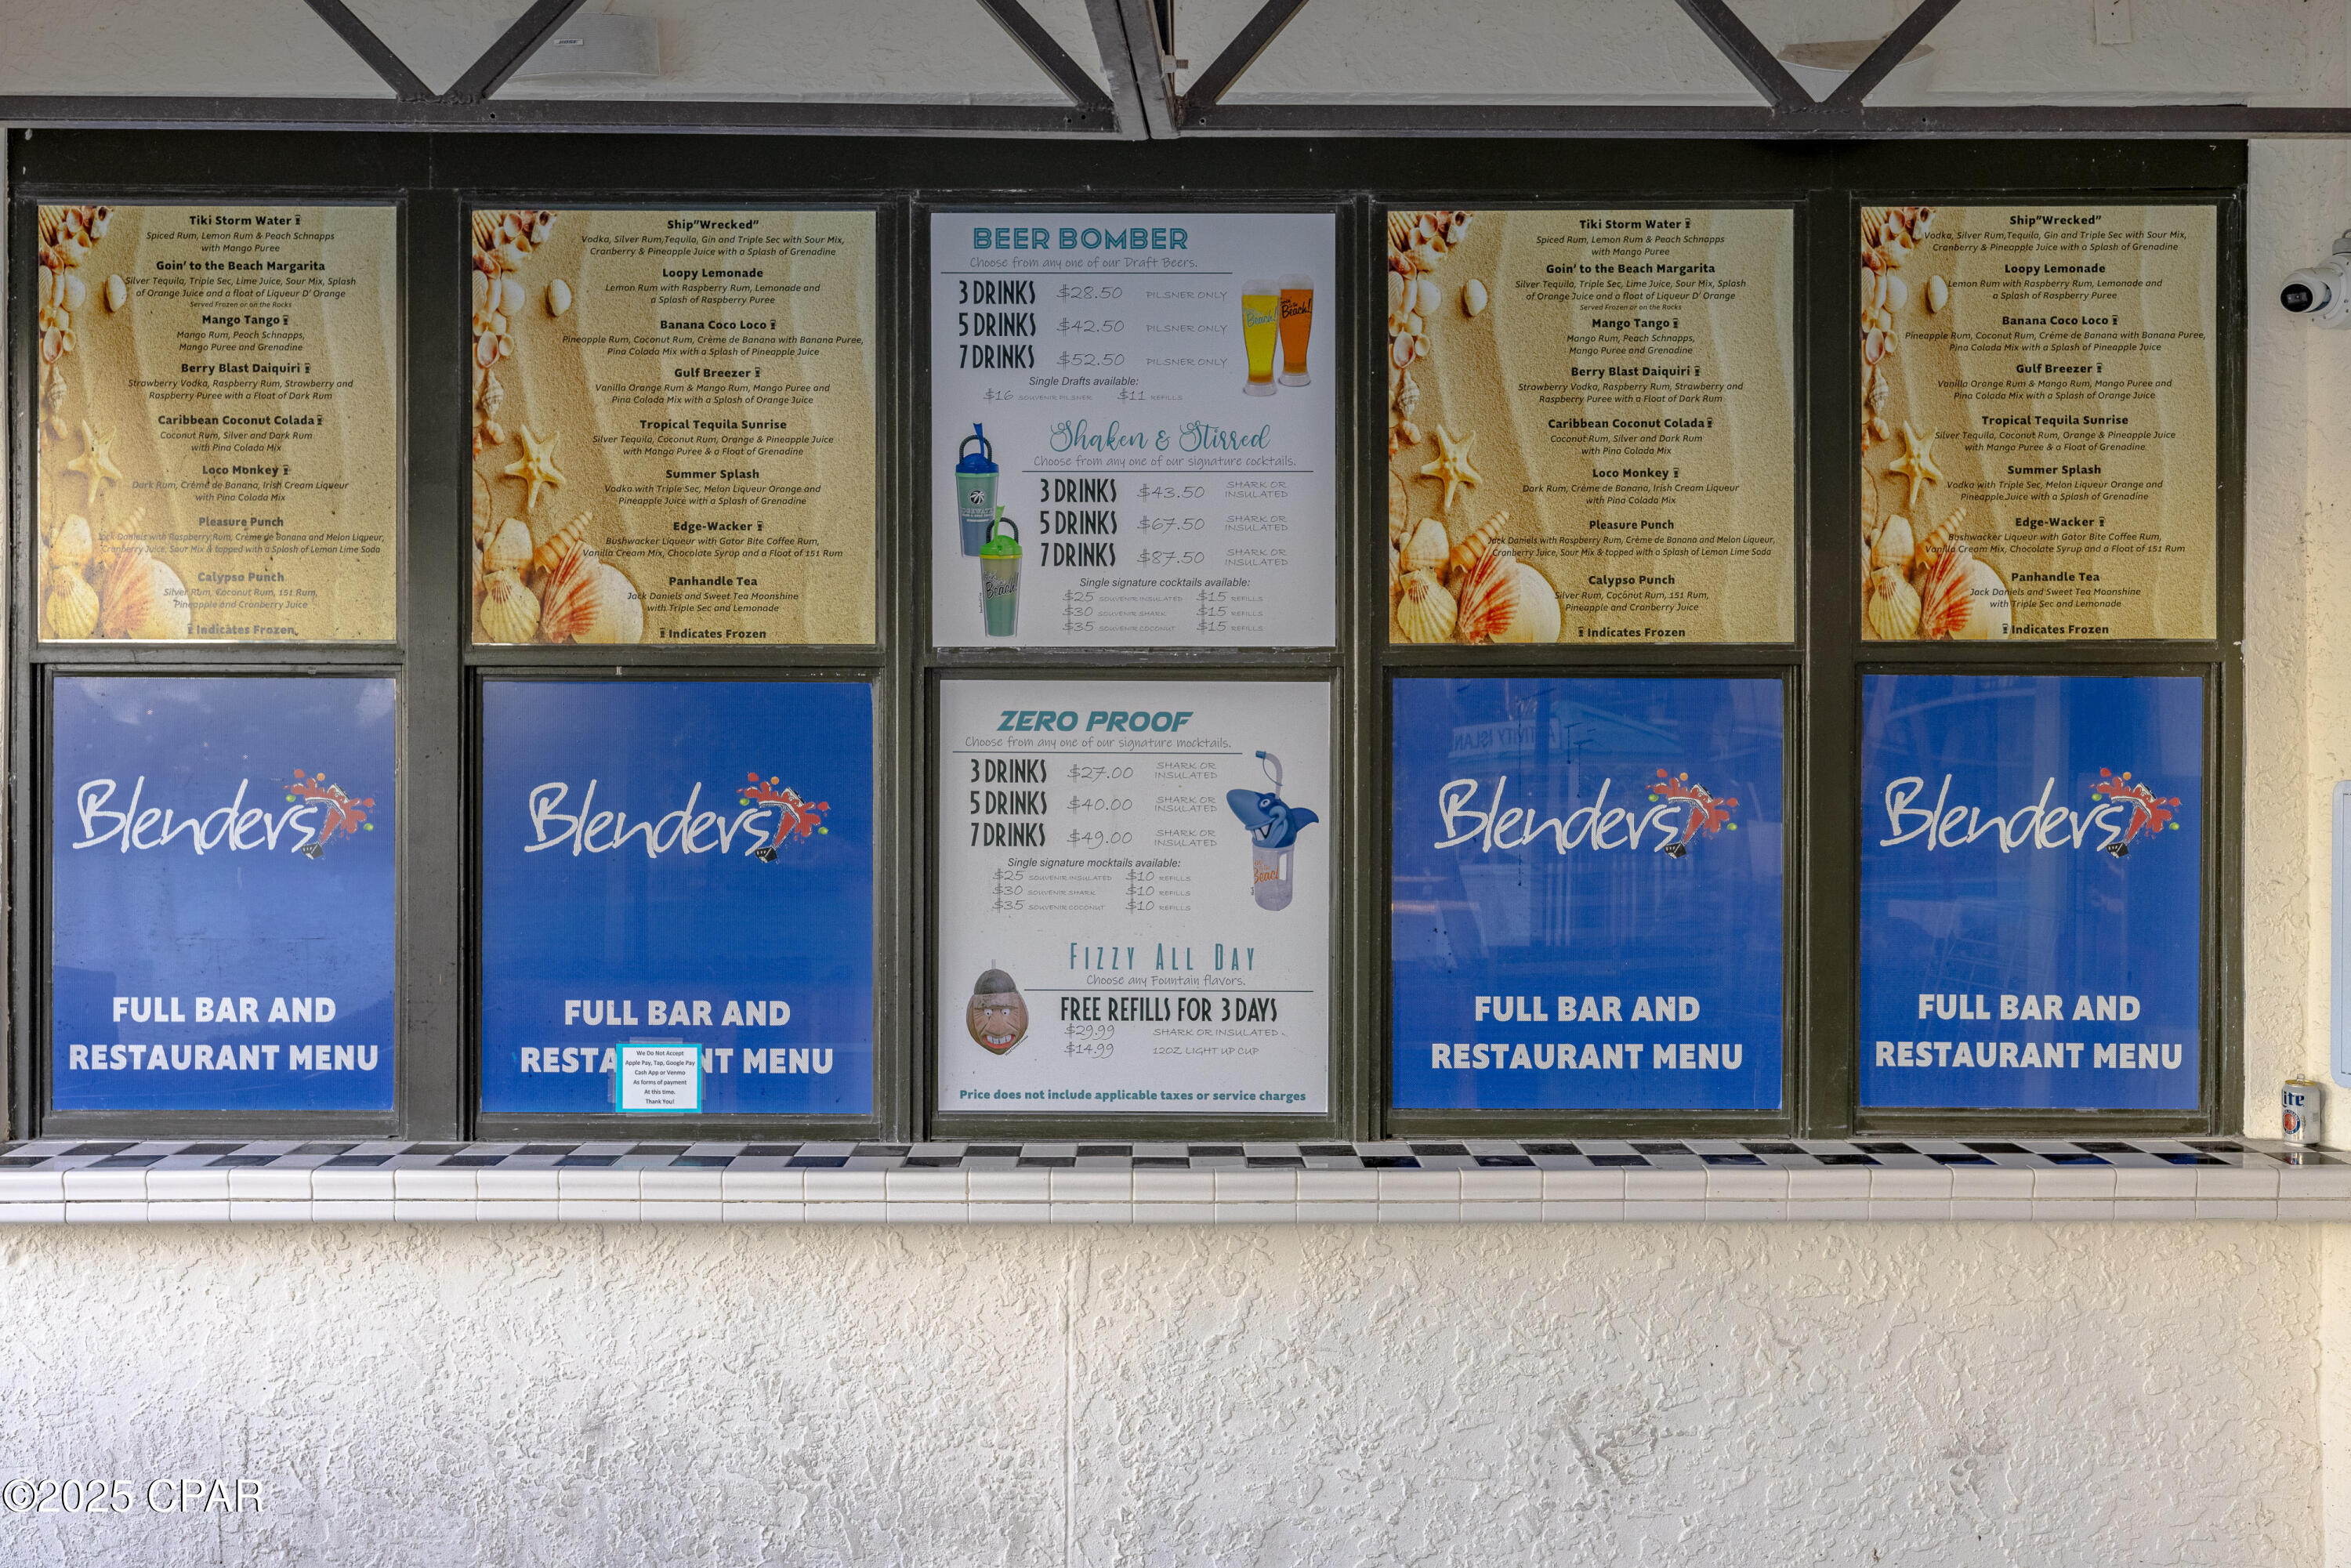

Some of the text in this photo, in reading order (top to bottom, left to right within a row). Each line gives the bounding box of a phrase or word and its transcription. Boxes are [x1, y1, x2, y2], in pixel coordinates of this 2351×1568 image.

[190, 215, 292, 226] Tiki Storm Water
[974, 228, 1187, 249] BEER BOMBER
[190, 261, 201, 270] to
[205, 260, 224, 270] the
[229, 260, 263, 271] Beach
[267, 260, 324, 273] Margarita
[663, 267, 763, 281] Loopy Lemonade
[2005, 263, 2105, 276] Loopy Lemonade
[638, 284, 657, 292] Rum
[683, 283, 727, 294] Raspberry
[730, 284, 752, 294] Rum,
[755, 284, 800, 292] Lemonade
[804, 284, 820, 292] and
[959, 281, 1035, 304] 3 DRINKS
[1056, 284, 1122, 301] $28.50
[1147, 291, 1227, 302] PILSNER ONLY
[259, 300, 271, 309] the
[272, 300, 292, 309] Rocks
[1281, 299, 1312, 318] Beach!
[203, 315, 279, 328] Mango Tango
[661, 320, 766, 330] Banana Coco Loco
[959, 313, 1036, 336] 5 DRINKS
[1056, 317, 1124, 335] $42.50
[960, 345, 1034, 368] 7 DRINKS
[1056, 351, 1125, 368] $52.50
[182, 362, 299, 376] Berry Blast Daiquiri
[675, 368, 751, 378] Gulf Breezer
[1030, 375, 1139, 388] Single Drafts available:
[640, 418, 786, 432] Tropical Tequila Sunrise
[1549, 418, 1704, 429] Caribbean Coconut Colada
[1050, 419, 1270, 452] Shaken & Stirred
[203, 464, 278, 478] Loco Monkey
[2008, 464, 2100, 477] Summer Splash
[1041, 479, 1117, 502] 3 DRINKS
[1137, 483, 1204, 502] $43.50
[674, 520, 752, 534] Edge-Wacker
[1137, 516, 1204, 534] $67.50
[1589, 519, 1673, 530] Pleasure Punch
[1136, 549, 1204, 567] $87.50
[669, 575, 757, 586] Panhandle Tea
[1588, 574, 1675, 588] Calypso Punch
[669, 628, 766, 639] Indicates Frozen
[997, 711, 1194, 732] ZERO PROOF
[1067, 764, 1133, 783] $27.00
[74, 777, 317, 854] Blenders
[525, 780, 772, 857] Blenders
[1435, 777, 1681, 854] Blenders
[1881, 774, 2124, 853] Blenders
[114, 997, 335, 1023] FULL BAR AND
[565, 1000, 790, 1026] FULL BAR AND
[1061, 997, 1277, 1022] FREE REFILLS FOR 3 DAYS
[1919, 994, 2140, 1020] FULL BAR AND
[1064, 1023, 1114, 1040] $29.99
[70, 1045, 378, 1070] RESTAURANT MENU
[1063, 1041, 1114, 1059] $14.99
[1876, 1041, 2182, 1069] RESTAURANT MENU
[522, 1047, 832, 1074] RESTANT MENU
[960, 1088, 1306, 1104] Price does not include applicable taxes or service charges
